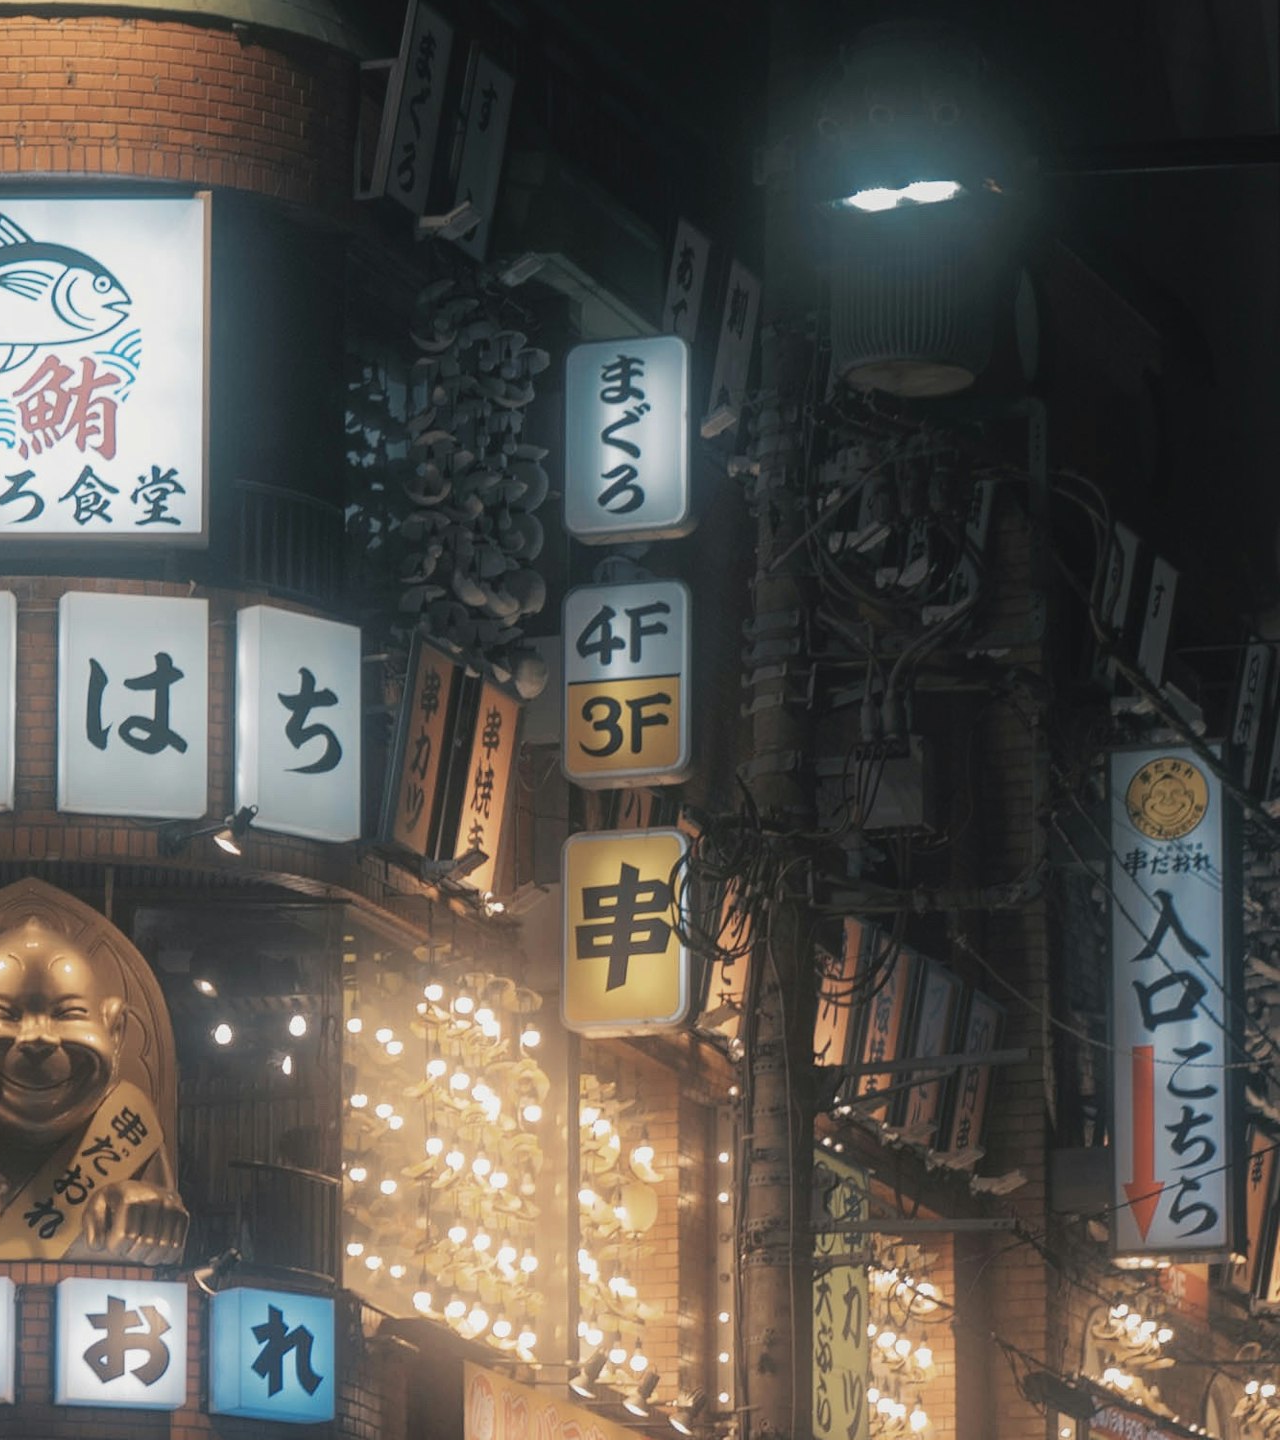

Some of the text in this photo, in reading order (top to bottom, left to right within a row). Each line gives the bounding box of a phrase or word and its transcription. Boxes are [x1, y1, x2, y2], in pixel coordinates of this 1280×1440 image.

[13, 354, 121, 460] 鮪
[598, 353, 650, 514] まぐろ
[576, 601, 671, 667] 4F
[404, 665, 438, 833] 串カツ
[579, 693, 672, 758] 3F
[1122, 849, 1212, 877] 串だおれ
[574, 862, 674, 992] 串
[23, 1105, 149, 1240] 串だおれ
